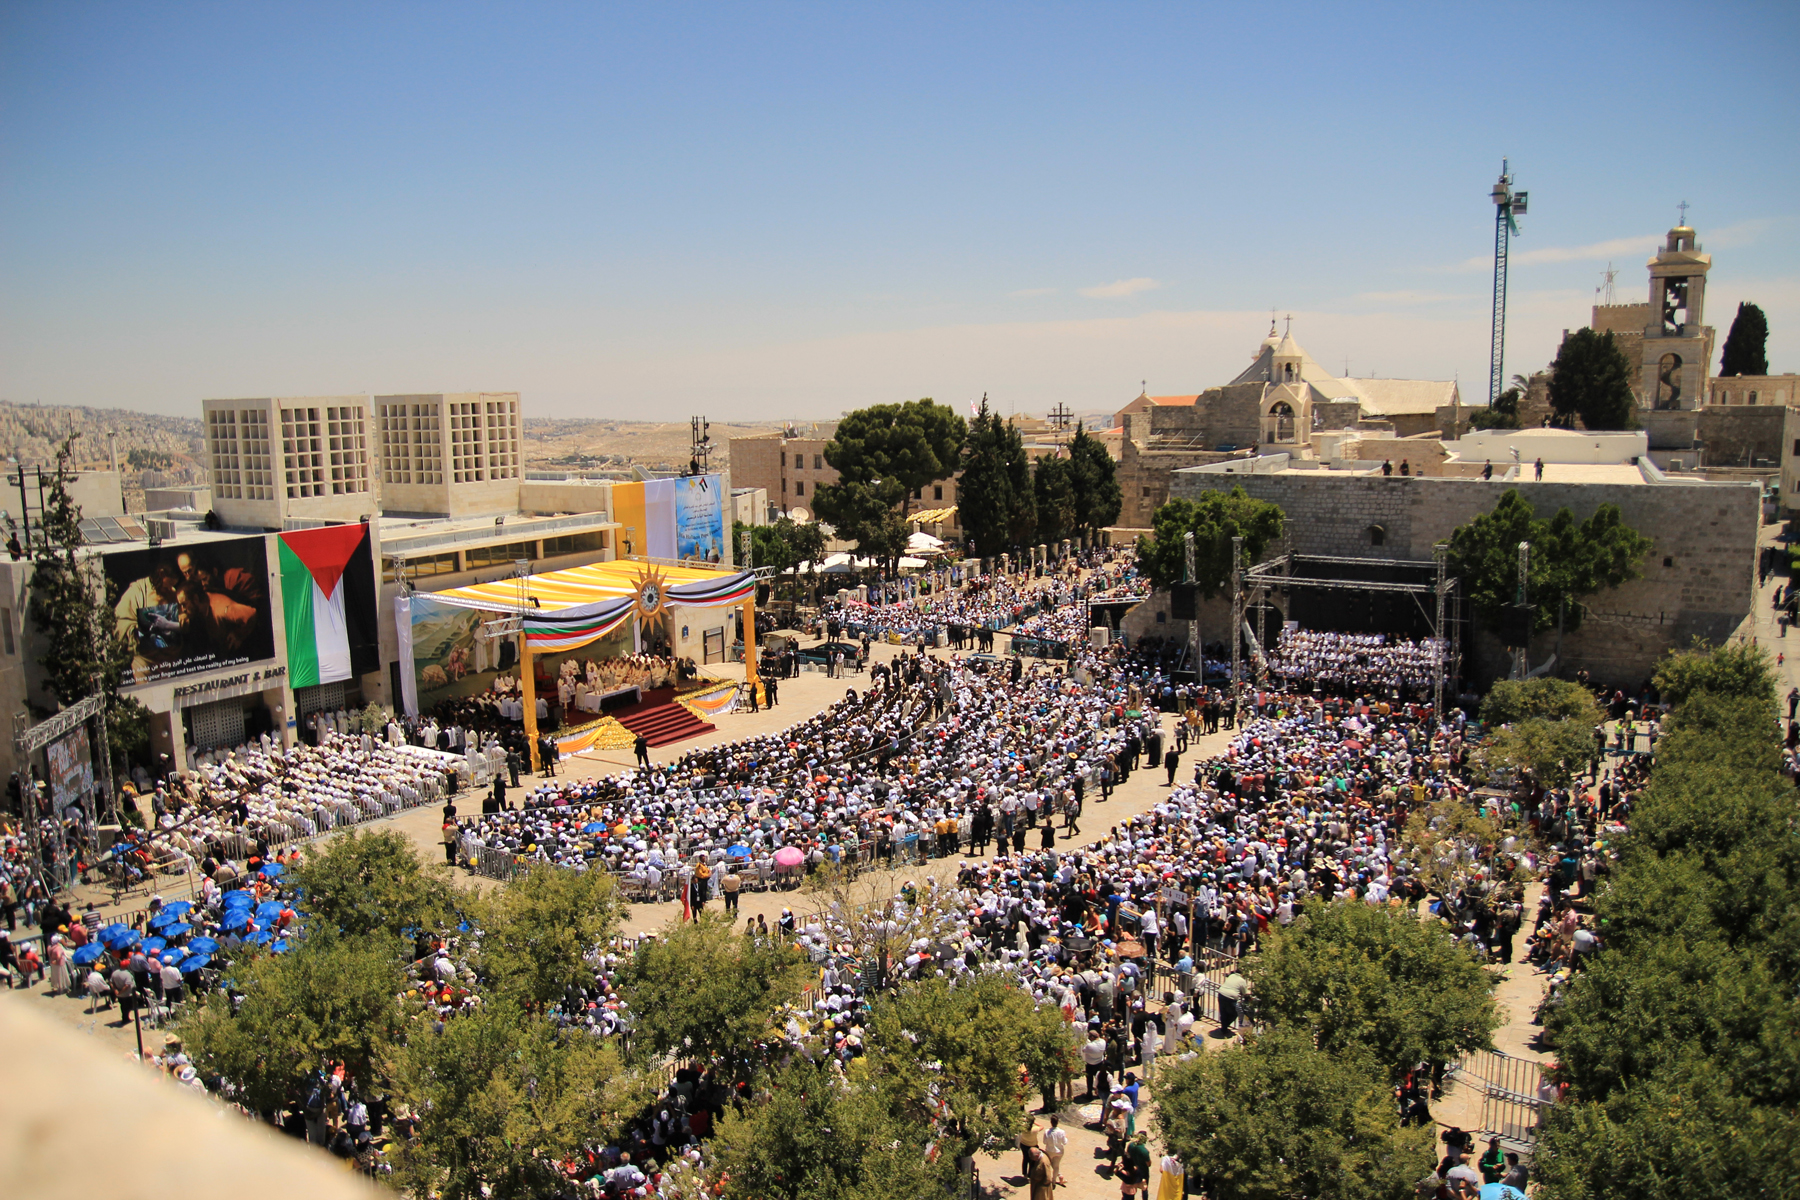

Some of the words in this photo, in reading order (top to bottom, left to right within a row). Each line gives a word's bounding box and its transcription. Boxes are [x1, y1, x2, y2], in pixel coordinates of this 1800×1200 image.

[174, 674, 250, 698] RESTAURANT
[253, 672, 261, 681] &
[264, 666, 286, 679] BAR
